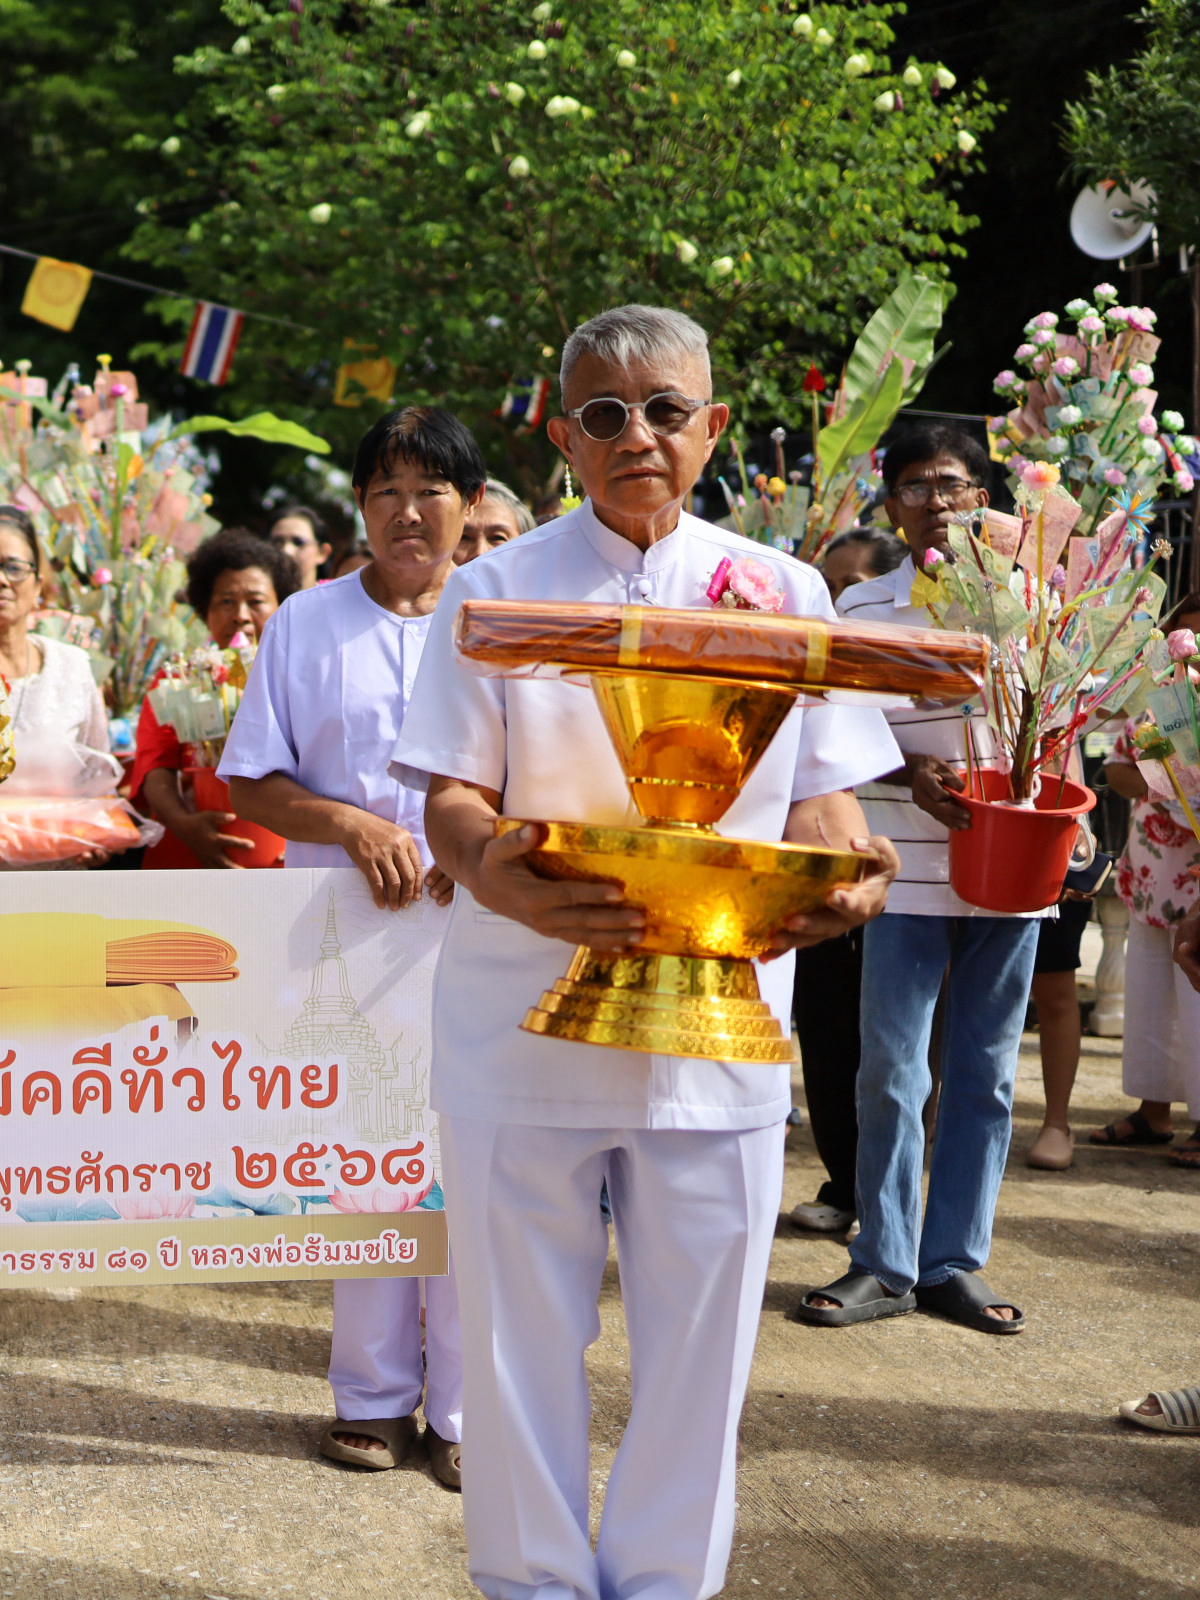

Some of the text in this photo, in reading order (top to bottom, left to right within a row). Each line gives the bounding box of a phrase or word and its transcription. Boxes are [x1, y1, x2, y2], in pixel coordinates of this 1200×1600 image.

[231, 1141, 425, 1189] ๒๕๖๘
[108, 1250, 147, 1269] ๘๑
[160, 1239, 178, 1267] ปี
[191, 1232, 414, 1266] หลวงพ่อธัมมชโย
